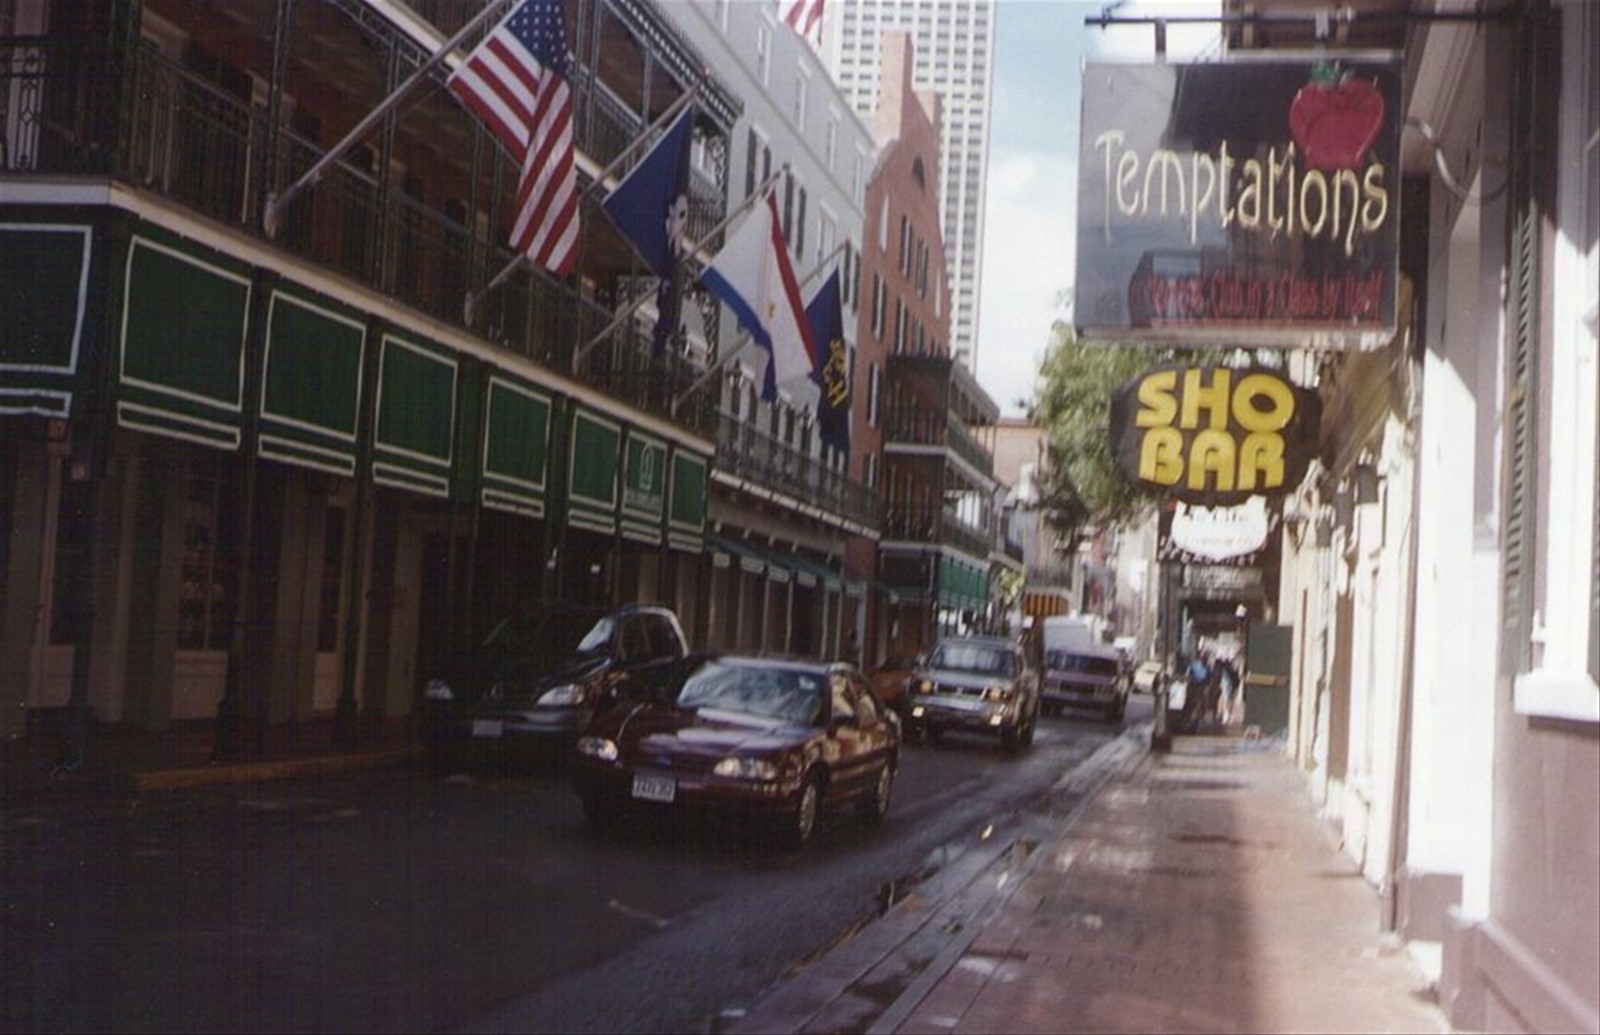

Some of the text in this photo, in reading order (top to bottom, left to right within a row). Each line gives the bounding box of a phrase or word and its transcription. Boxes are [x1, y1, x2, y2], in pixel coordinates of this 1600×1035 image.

[1095, 129, 1388, 257] Temptations
[1136, 368, 1295, 432] SHO
[1139, 427, 1286, 491] BAR
